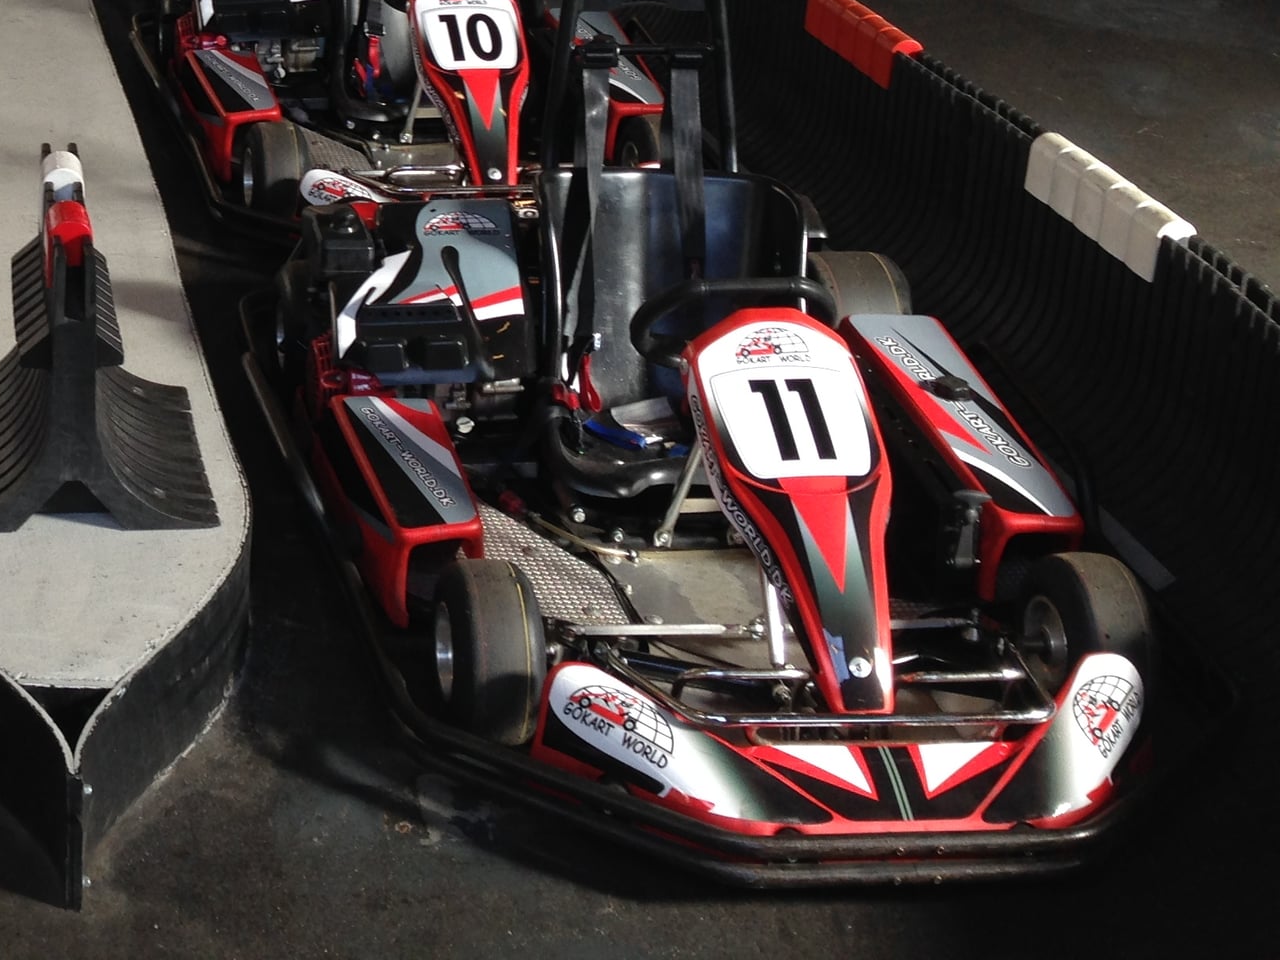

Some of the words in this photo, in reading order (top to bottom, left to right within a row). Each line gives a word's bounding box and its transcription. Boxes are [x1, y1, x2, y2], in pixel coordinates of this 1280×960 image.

[438, 13, 503, 62] 10
[748, 378, 837, 461] 11
[361, 406, 457, 508] GOKART-WORLD.DK
[563, 701, 616, 737] GOKART
[621, 731, 669, 770] WORLD
[1097, 718, 1124, 759] GOKART
